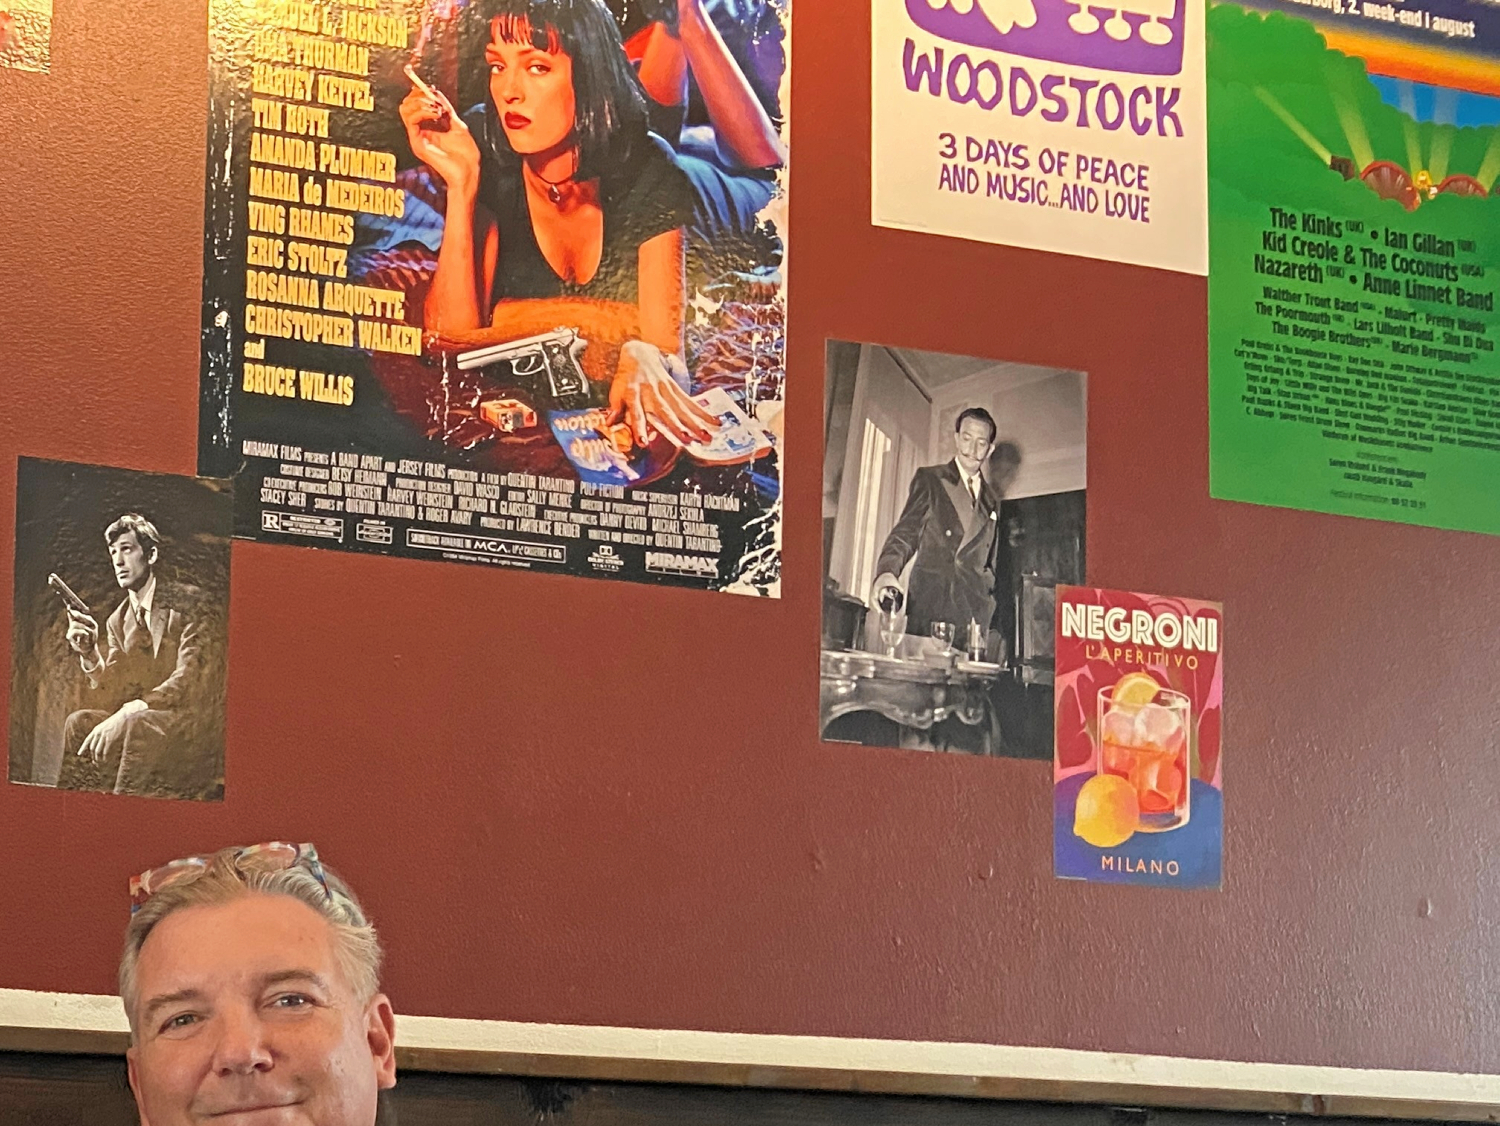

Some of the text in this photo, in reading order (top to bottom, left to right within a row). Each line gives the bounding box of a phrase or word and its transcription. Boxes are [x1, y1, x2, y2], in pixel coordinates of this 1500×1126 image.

[341, 10, 408, 48] JACKSON
[1363, 2, 1422, 28] week-end
[1432, 15, 1476, 38] august
[292, 37, 369, 76] THURMAN
[252, 63, 374, 111] HARVEY KEITEL
[902, 37, 1184, 138] WOODSTOCK
[252, 98, 330, 138] TIM ROTH
[251, 132, 396, 183] AMANDA PLUMMER
[938, 132, 1150, 192] 3 DAYS OF PEACE
[249, 167, 404, 218] MARIA de MEDEIROS
[938, 163, 979, 195] AND
[1105, 189, 1150, 223] LOVE
[248, 201, 354, 245] VING RHAMES
[1270, 207, 1297, 231] The
[1302, 212, 1343, 238] Kinks
[1384, 227, 1409, 250] Ian
[1413, 232, 1455, 258] Gillan
[247, 236, 347, 278] ERIC STOLTZ
[1262, 231, 1287, 253] Kid
[1292, 235, 1339, 263] Creole
[1343, 244, 1356, 265] &
[1360, 247, 1387, 271] The
[1391, 253, 1459, 282] Coconuts
[246, 270, 405, 319] ROSANNA ARQUETTE
[1254, 254, 1324, 284] Nazareth
[1363, 272, 1401, 297] Anne
[1405, 279, 1453, 305] Linnet
[1456, 287, 1494, 313] Band
[1255, 301, 1273, 316] The
[1334, 298, 1359, 313] Band
[244, 339, 265, 359] and
[245, 304, 422, 356] CHRISTOPHER WALKEN
[1272, 320, 1289, 336] The
[243, 362, 354, 406] BRUCE WILLIS
[242, 440, 279, 459] MIRAMAX
[280, 445, 302, 462] FILMS
[330, 451, 337, 466] A
[360, 455, 383, 471] APART
[398, 459, 423, 476] JERSEY
[425, 462, 446, 479] FILMS
[260, 488, 286, 505] STACEY
[288, 492, 307, 508] SHER
[263, 513, 279, 529] R
[645, 552, 719, 572] MIRAMAX
[1061, 602, 1218, 653] NEGRONI
[1085, 644, 1198, 670] L'APERITIVO
[1101, 855, 1180, 876] MILANO
